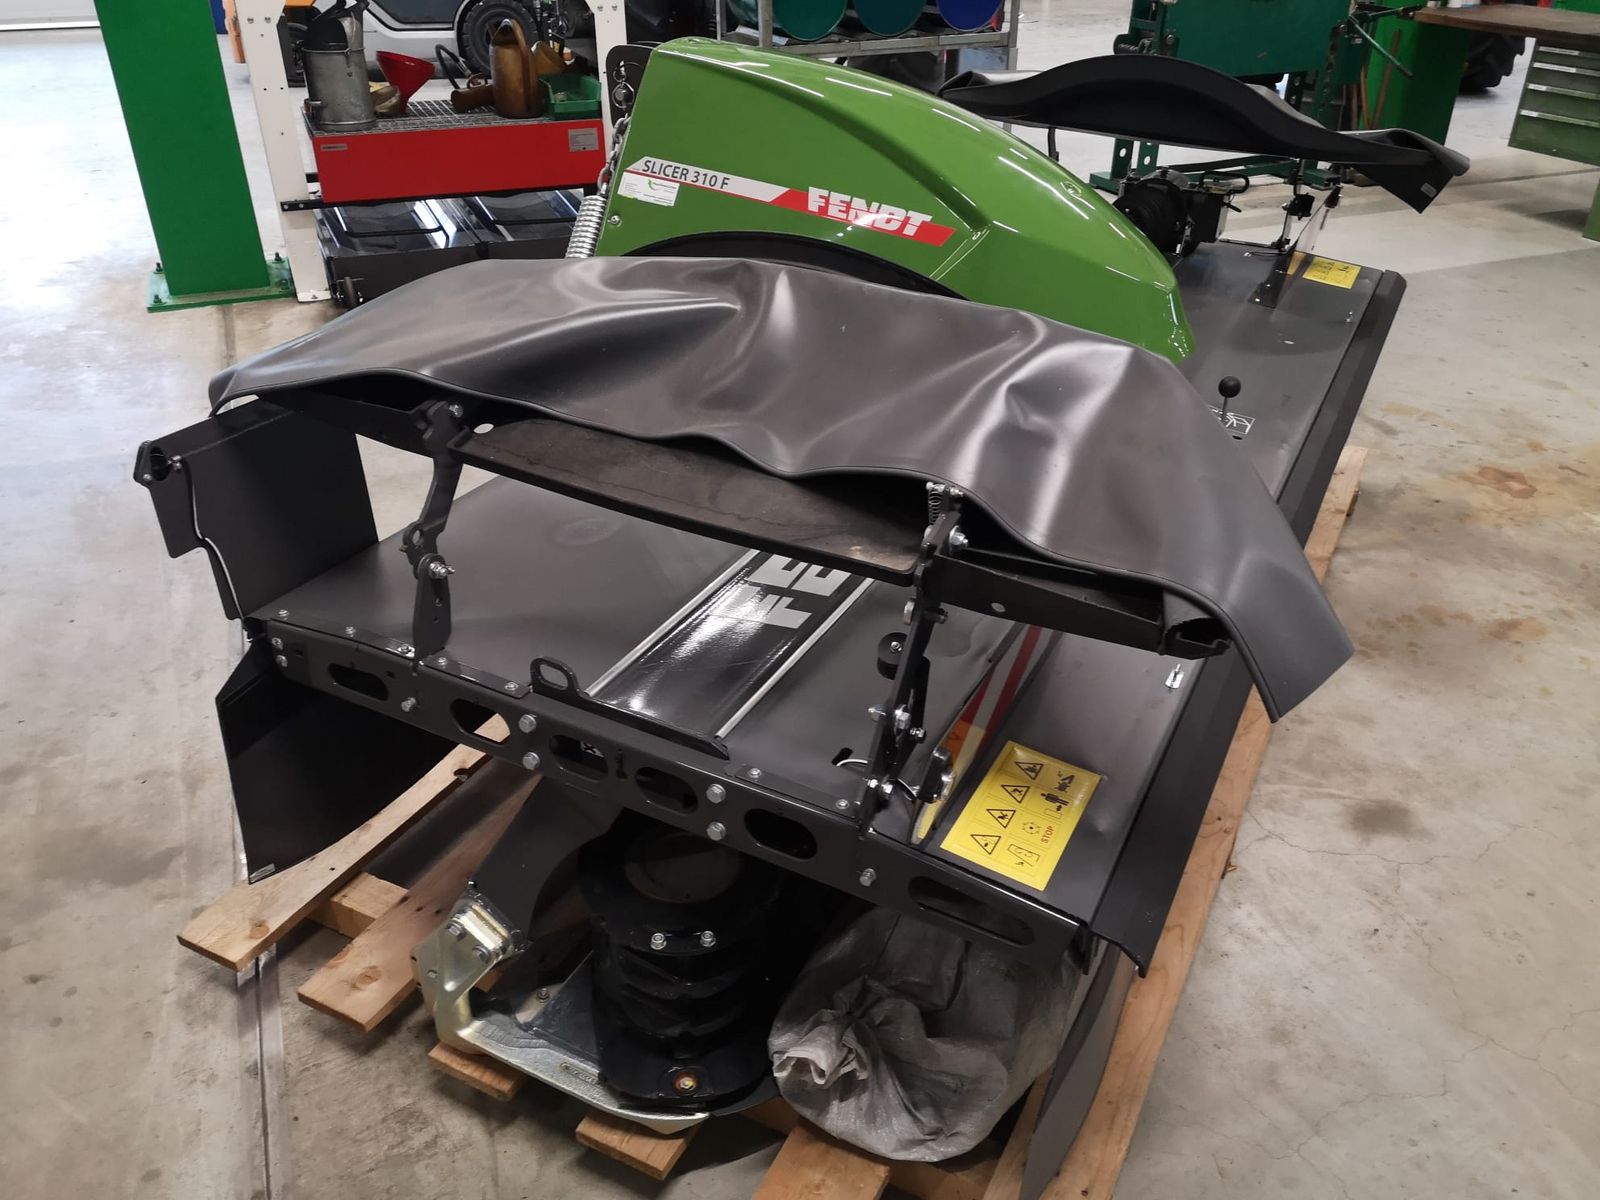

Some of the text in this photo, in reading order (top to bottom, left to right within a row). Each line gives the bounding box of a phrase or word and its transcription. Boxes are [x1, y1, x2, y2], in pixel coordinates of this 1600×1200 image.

[642, 160, 689, 181] SLICER
[691, 171, 718, 187] 310
[720, 177, 730, 189] F
[807, 186, 933, 236] FENDT
[1040, 825, 1054, 844] STOP
